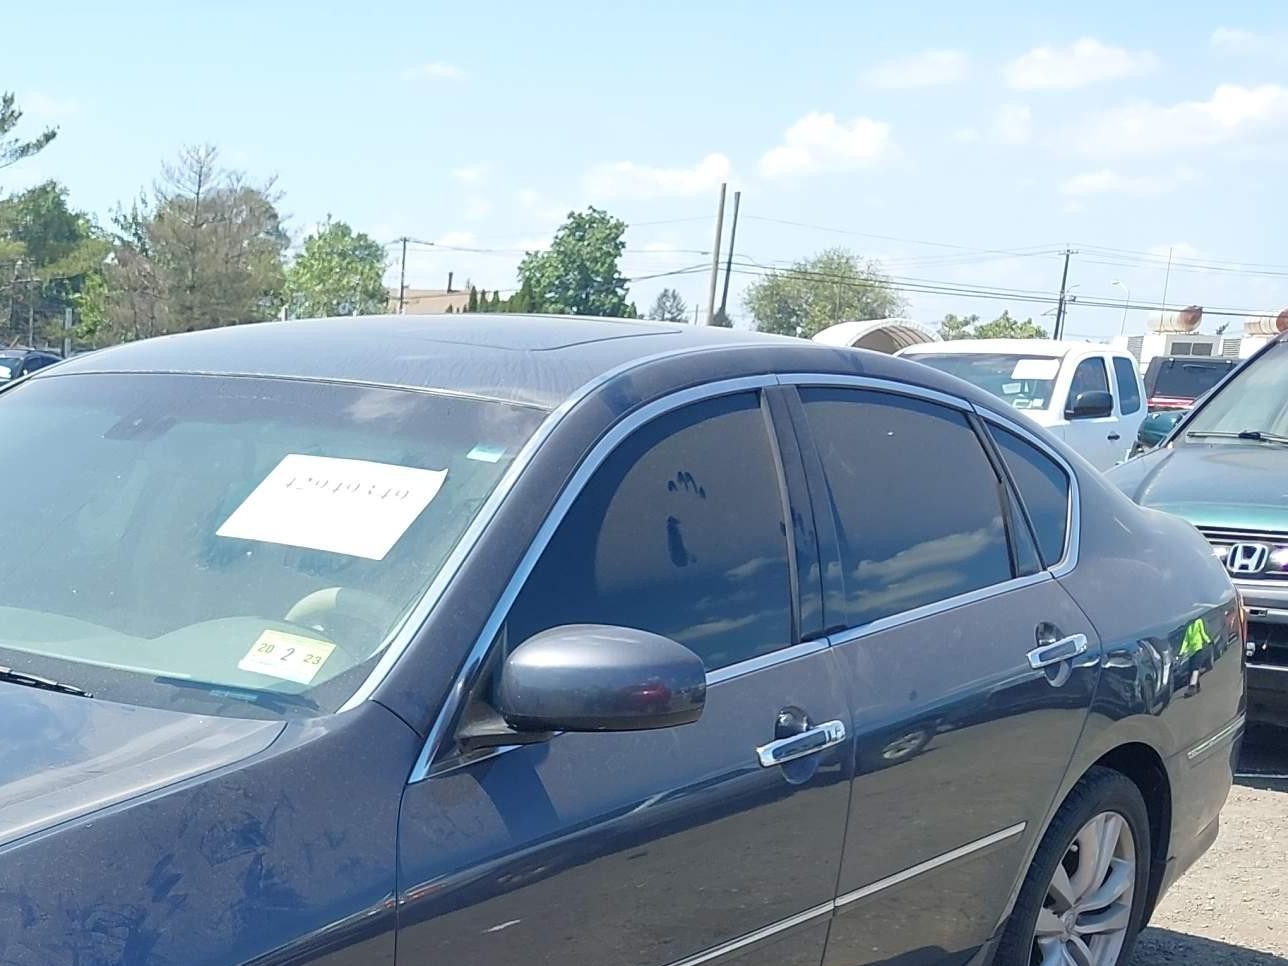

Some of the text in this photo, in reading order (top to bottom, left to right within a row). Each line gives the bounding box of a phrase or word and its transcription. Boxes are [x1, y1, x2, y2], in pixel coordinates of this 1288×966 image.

[257, 642, 275, 653] 20
[280, 647, 295, 661] 2
[303, 654, 322, 665] 23
